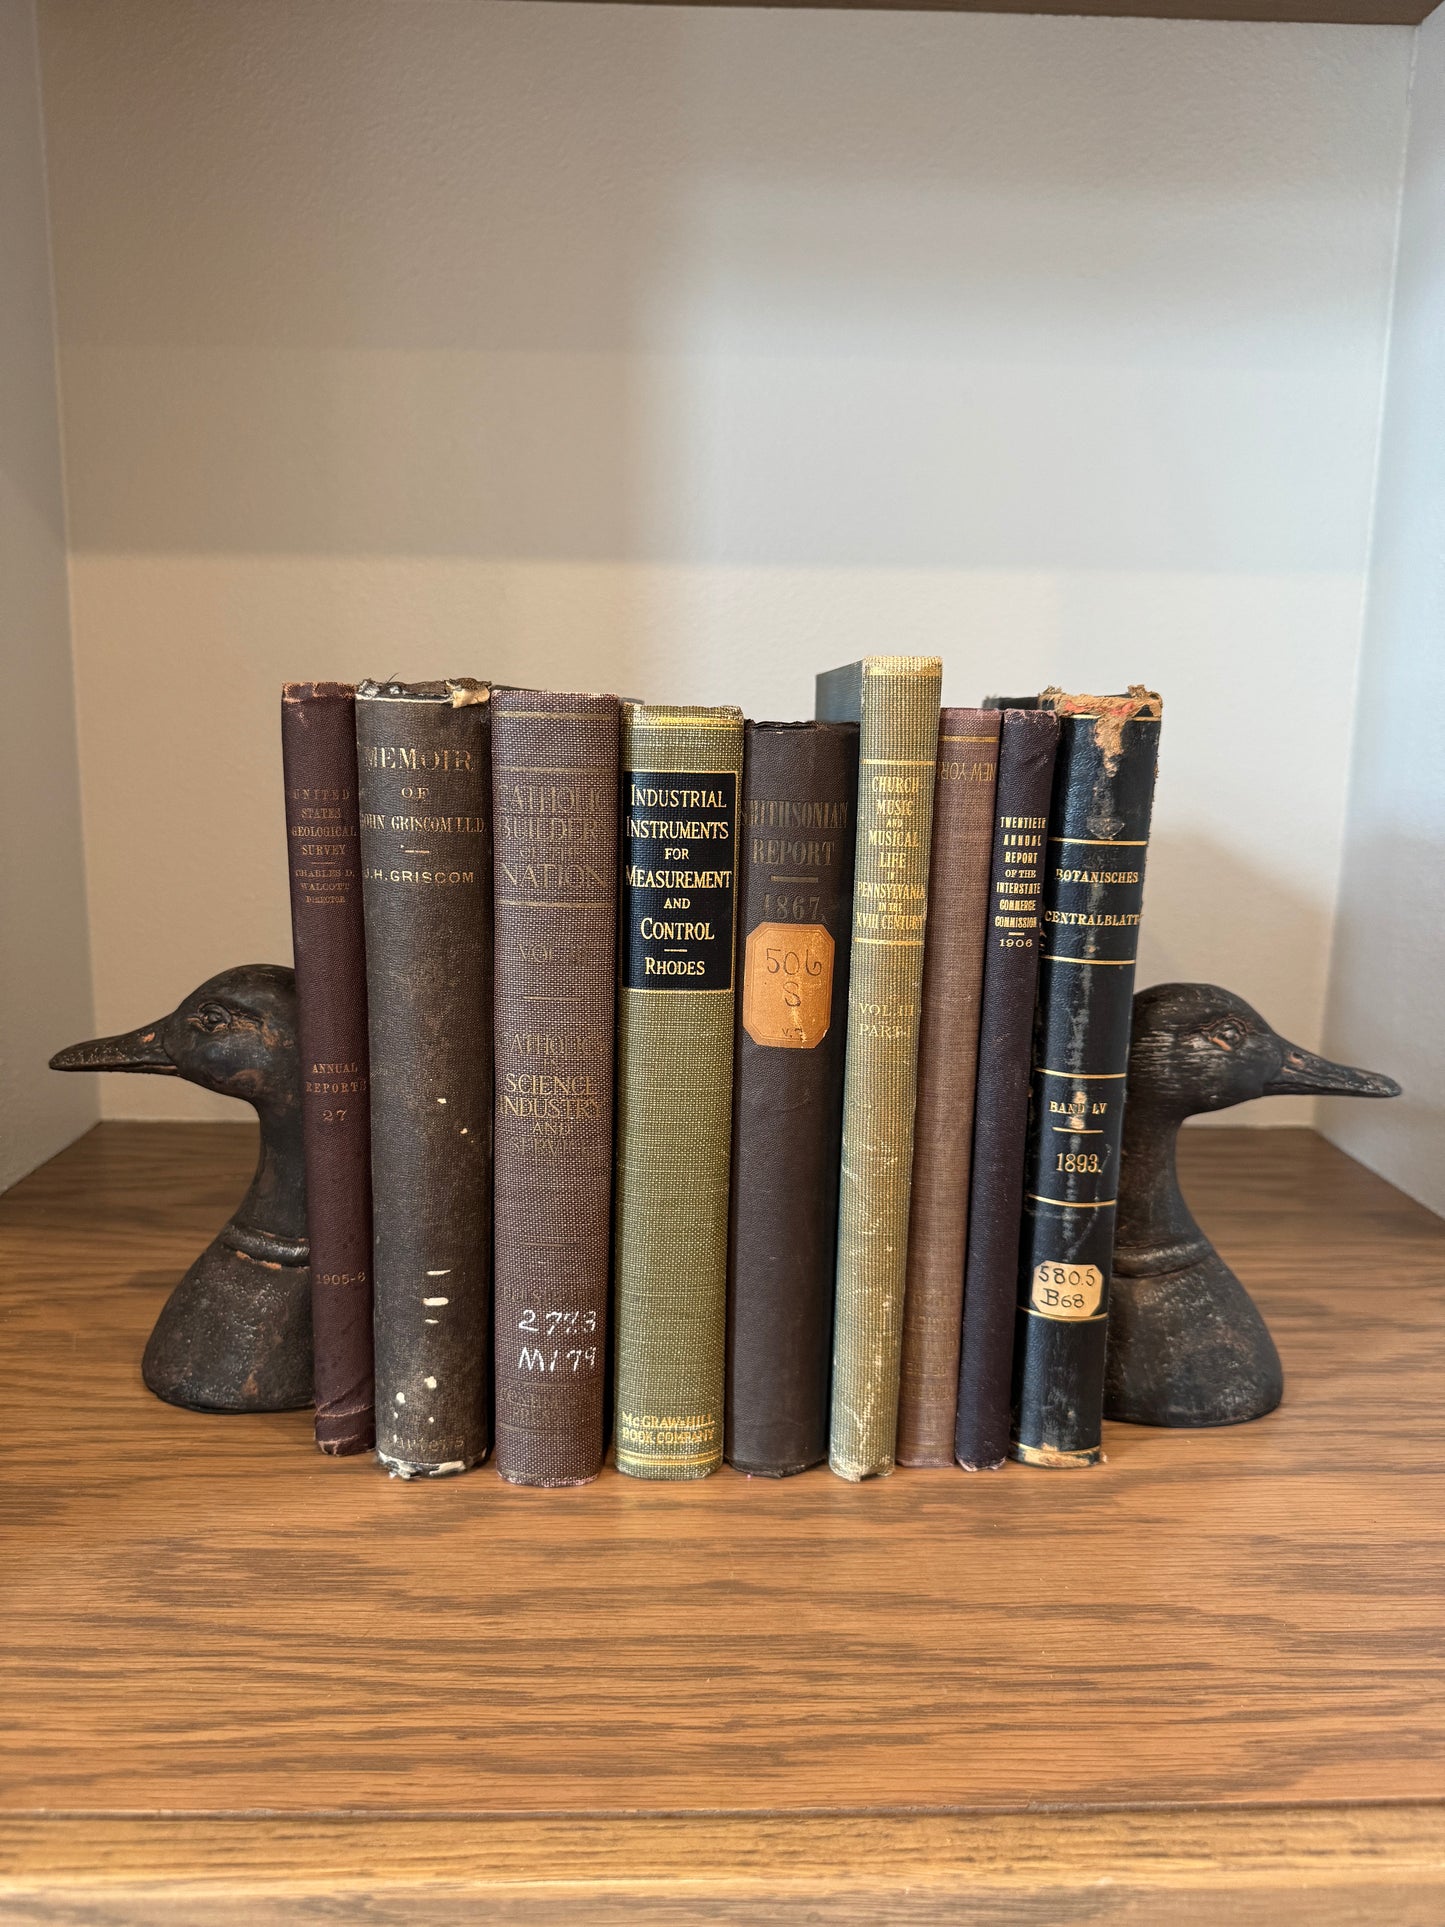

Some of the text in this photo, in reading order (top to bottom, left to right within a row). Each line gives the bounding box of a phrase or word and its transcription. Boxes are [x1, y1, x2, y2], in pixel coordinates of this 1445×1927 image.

[364, 746, 475, 772] MEMOIR
[970, 762, 997, 781] NEW
[872, 775, 920, 793] CHURCH
[401, 787, 430, 800] OF
[630, 784, 727, 809] INDUSTRIAL
[301, 807, 341, 819] STATES
[876, 800, 914, 816] MUSIC
[391, 815, 453, 833] GRISCOM
[626, 816, 729, 839] INSTRUMENTS
[886, 818, 904, 828] AND
[1000, 816, 1046, 829] TWENTIETH
[291, 826, 357, 837] GEOLOGICAL
[868, 830, 919, 847] MUSICAL
[1003, 834, 1042, 847] ANNUAL
[302, 844, 346, 856] SURVEY
[664, 848, 689, 860] FOR
[751, 838, 834, 866] REPORT
[1004, 851, 1038, 864] REPORT
[879, 852, 907, 868] LIFE
[295, 869, 341, 878] CHARLES
[500, 863, 608, 889] NATION
[626, 865, 732, 889] MEASUREMENT
[887, 871, 895, 880] IN
[1005, 869, 1036, 878] OF THE
[1055, 868, 1139, 884] BOTANISCHES
[300, 882, 350, 891] WALCOTT
[857, 881, 926, 899] PENNSYLVANIA
[996, 881, 1040, 894] INTERSTATE
[663, 898, 690, 909] AND
[763, 895, 821, 921] 1867
[878, 901, 903, 912] IN THE
[999, 899, 1037, 911] COMMERCE
[640, 917, 715, 941] CONTROL
[881, 913, 923, 930] CENTURY
[994, 915, 1037, 928] COMMISSION
[999, 938, 1033, 948] 1906
[644, 957, 705, 975] RHODES
[766, 947, 823, 977] 506
[782, 981, 802, 1008] S
[858, 1023, 903, 1039] PART
[311, 1062, 358, 1074] ANNUAL
[505, 1073, 599, 1096] SCIENCE
[322, 1109, 348, 1122] 27
[500, 1096, 602, 1119] INDUSTRY
[1048, 1100, 1108, 1115] BAND LV
[532, 1121, 571, 1137] AND
[316, 1271, 366, 1286] 1905-6
[1038, 1265, 1096, 1287] 580.5
[1040, 1287, 1085, 1309] B68
[622, 1426, 715, 1445] BOOK COMPANY
